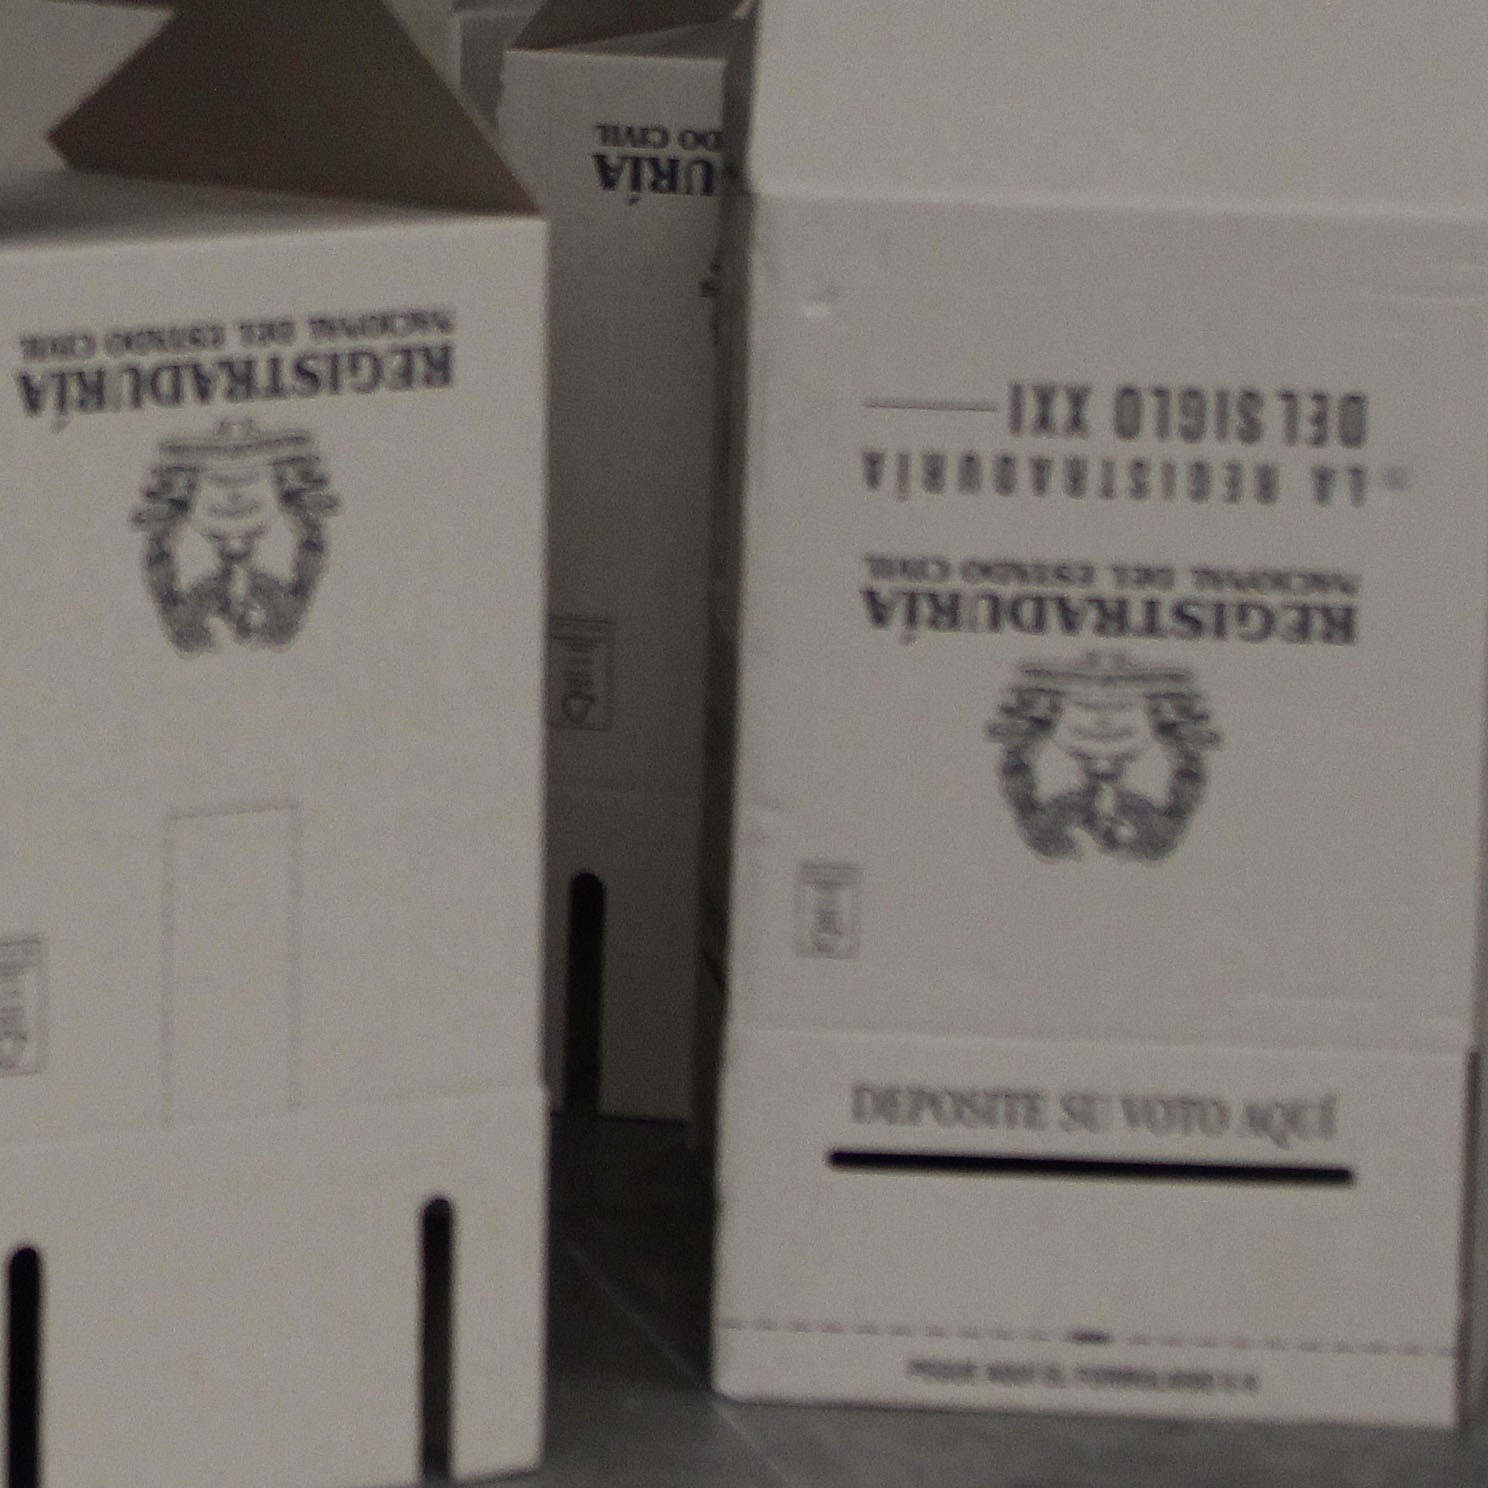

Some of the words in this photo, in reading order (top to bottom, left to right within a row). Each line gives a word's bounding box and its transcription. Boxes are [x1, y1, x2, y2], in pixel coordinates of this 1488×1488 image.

[15, 344, 455, 434] REGISTRADURÍA
[1008, 381, 1093, 440] XXI
[1114, 384, 1264, 445] SIGLO
[1278, 388, 1369, 449] DEL
[1311, 463, 1370, 508] LA
[860, 587, 1358, 647] REGISTRADURÍA
